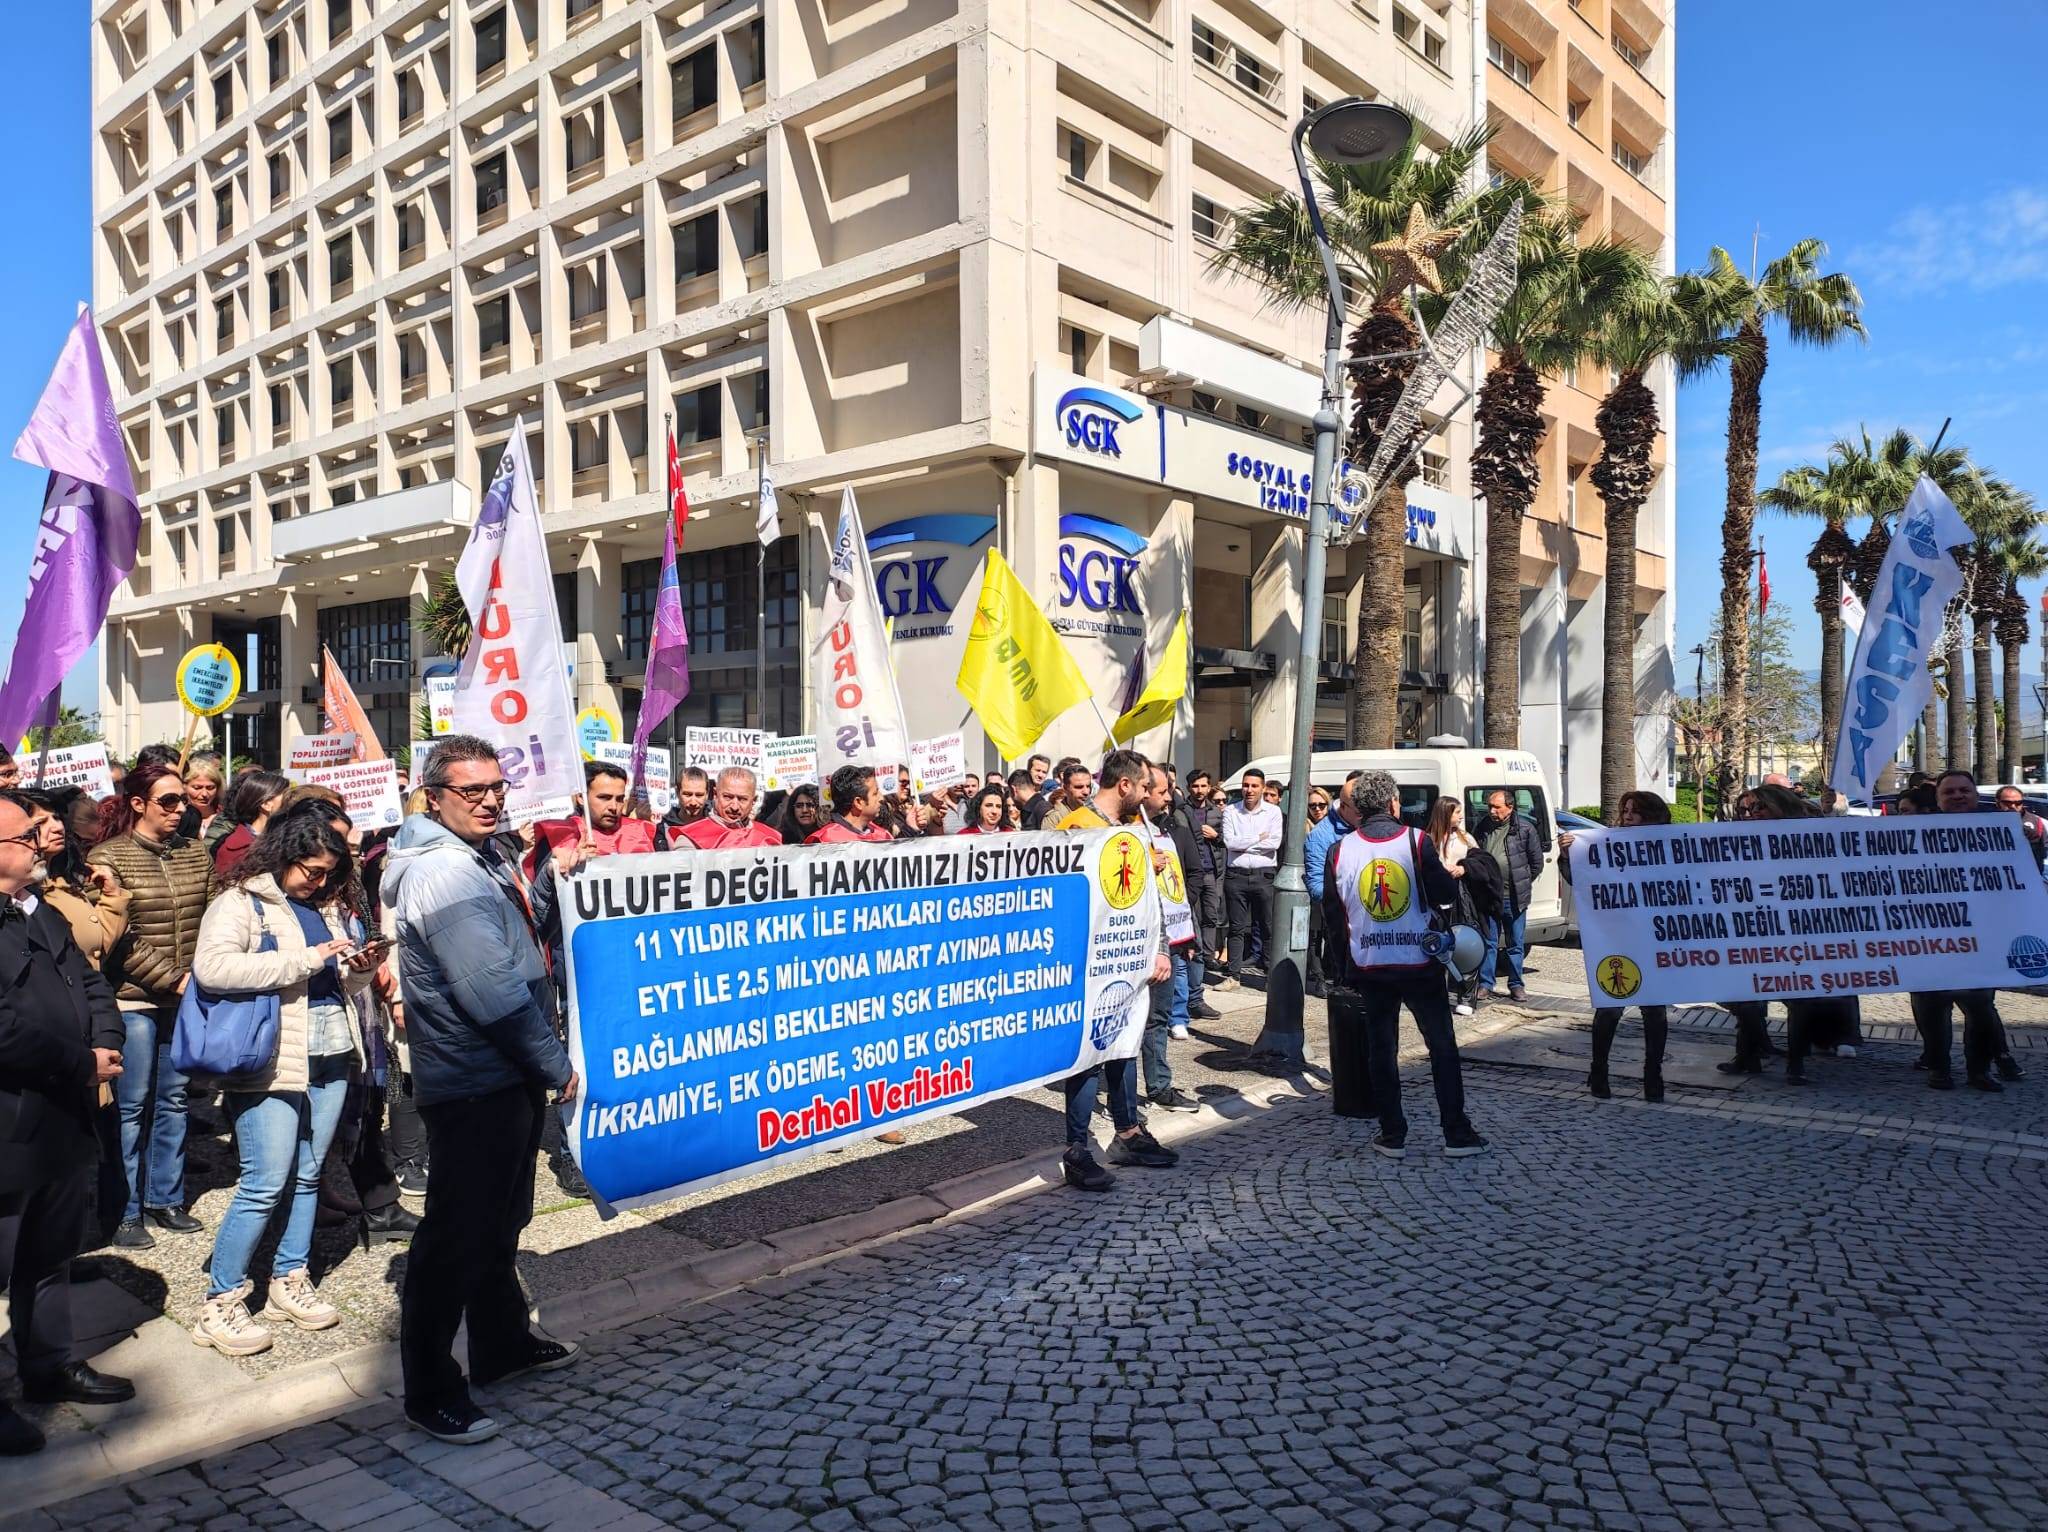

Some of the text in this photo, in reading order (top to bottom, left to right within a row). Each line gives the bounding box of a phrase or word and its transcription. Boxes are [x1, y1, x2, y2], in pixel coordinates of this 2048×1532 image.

[1066, 409, 1121, 457] SGK
[1227, 452, 1297, 490] SOSYAL
[1260, 482, 1309, 518] İZMİR
[876, 556, 951, 617] GK
[1059, 543, 1144, 616] SGK
[893, 625, 953, 639] ENLİK KURUMU
[1077, 620, 1112, 633] GÜVENLİK
[1113, 624, 1142, 637] KURUMU
[312, 739, 328, 748] YENİ
[688, 730, 760, 746] EMEKLİYE
[292, 751, 318, 759] TOPLU
[697, 742, 724, 753] NİSAN
[728, 745, 760, 756] ŞAKASI
[912, 743, 927, 755] Her
[56, 753, 73, 764] BİR
[70, 758, 105, 773] DÜZENİ
[690, 754, 759, 768] YAPILMAZ
[928, 753, 947, 765] Kreş
[1507, 759, 1537, 772] MALİYE
[25, 776, 70, 790] İNANCA
[71, 773, 88, 784] BİR
[311, 763, 393, 784] 3600 DÜZENLEMESİ
[344, 775, 388, 790] GÖSTERGE
[343, 787, 384, 801] ETSİZLİĞİ
[1588, 826, 2016, 872] 4 İŞLEM BİLMEYEN BAKANA VE HAVUZ MEDYASINA
[574, 842, 1085, 921] ULUFE DEĞİL HAKKIMIZI İSTİYORUZ
[1591, 881, 1638, 910] FAZLA
[1641, 874, 1693, 907] MESAİ
[1779, 874, 1814, 900] 2550
[1817, 873, 1838, 899] TL.
[1840, 865, 1897, 898] VERGİSİ
[1898, 863, 1969, 895] KESİLİNCE
[1971, 866, 2003, 891] 2160
[2003, 865, 2026, 890] TL.
[635, 885, 1053, 962] 11 YILDIR KHK İLE HAKLARI GASBEDİLEN
[1109, 914, 1135, 927] BÜRO
[1652, 899, 1972, 942] SADAKA DEĞİL HAKKIMIZI İSTİYORUZ
[1094, 928, 1148, 945] EMEKÇİLERİ
[1096, 944, 1144, 960] SENDİKASI
[1656, 936, 1978, 968] BÜRO EMEKÇİLERİ SENDİKASI
[2006, 952, 2048, 969] KES
[638, 927, 1055, 1017] EYT İLE 2.5 MİLYONA MART AYINDA MAAŞ
[1089, 957, 1147, 977] İZMİR ŞUBESİ
[1753, 964, 1899, 993] İZMİR ŞUBESİ
[612, 961, 1073, 1079] BAĞLANMASI BEKLENEN SGK EMEKÇİLERİNİN
[1089, 1006, 1132, 1041] KESK
[586, 1000, 1082, 1140] İKRAMİYE, EK ÖDEME, 3600 EK GÖSTERGE HAKKI
[758, 1056, 973, 1151] Derhal Verilsin!
